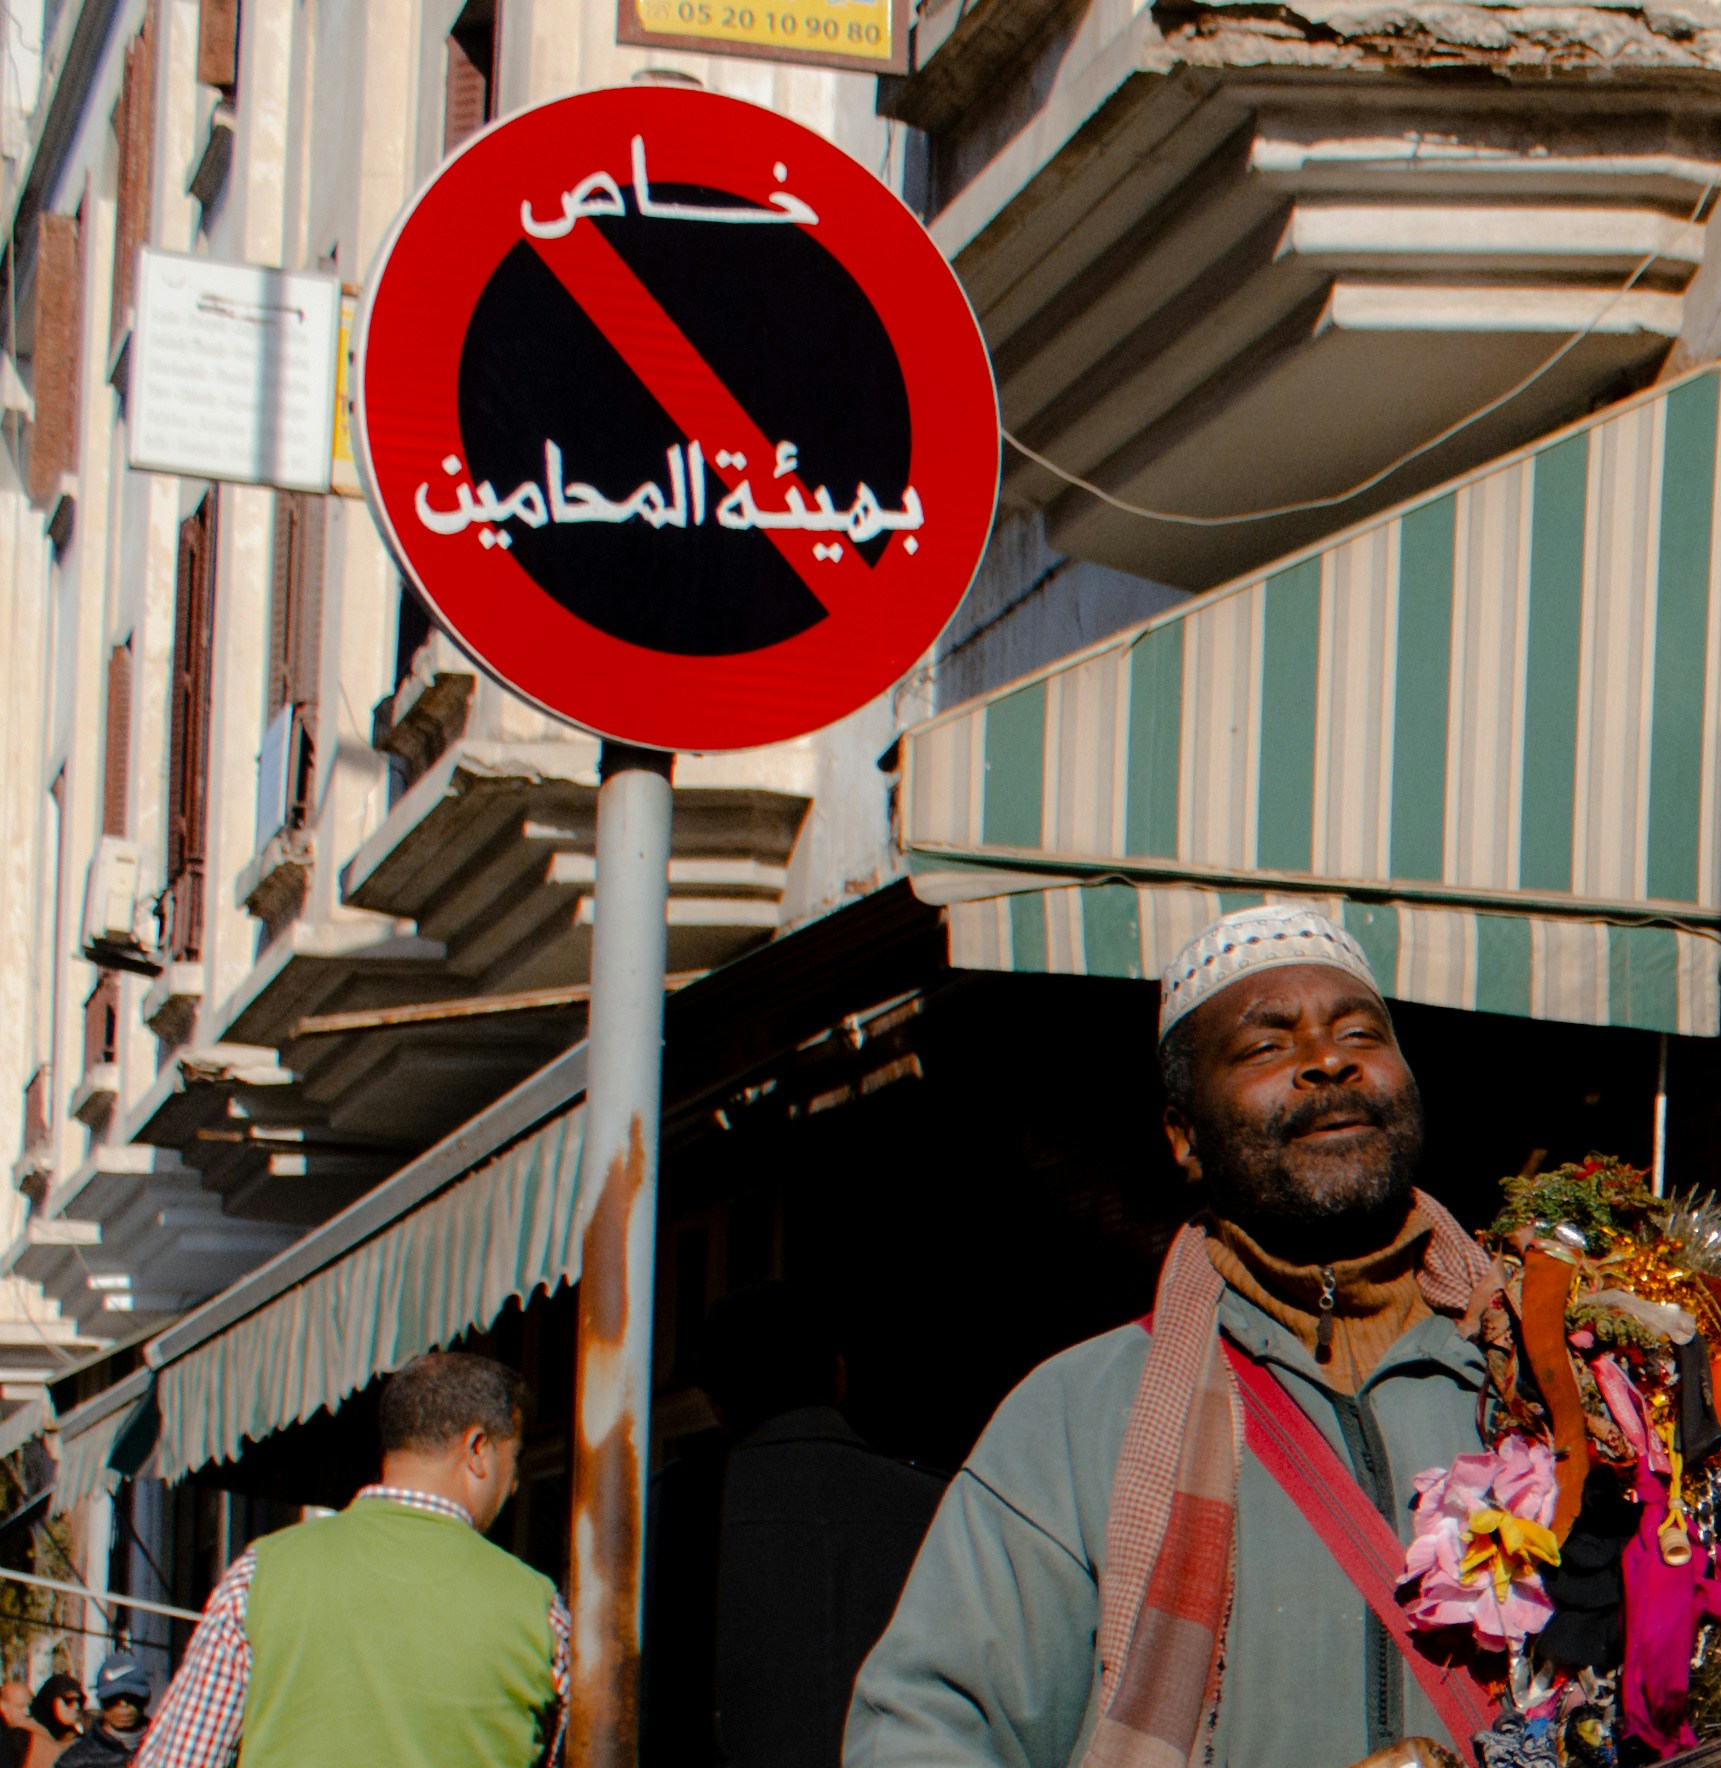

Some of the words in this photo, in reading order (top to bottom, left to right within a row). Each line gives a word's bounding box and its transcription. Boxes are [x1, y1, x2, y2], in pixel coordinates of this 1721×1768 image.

[677, 2, 711, 25] 05
[721, 7, 755, 29] 20
[766, 11, 796, 34] 10
[805, 17, 838, 39] 90
[847, 22, 881, 44] 80
[520, 134, 819, 239] خاص
[415, 438, 706, 549] المحامين
[715, 440, 925, 562] بهيئة
